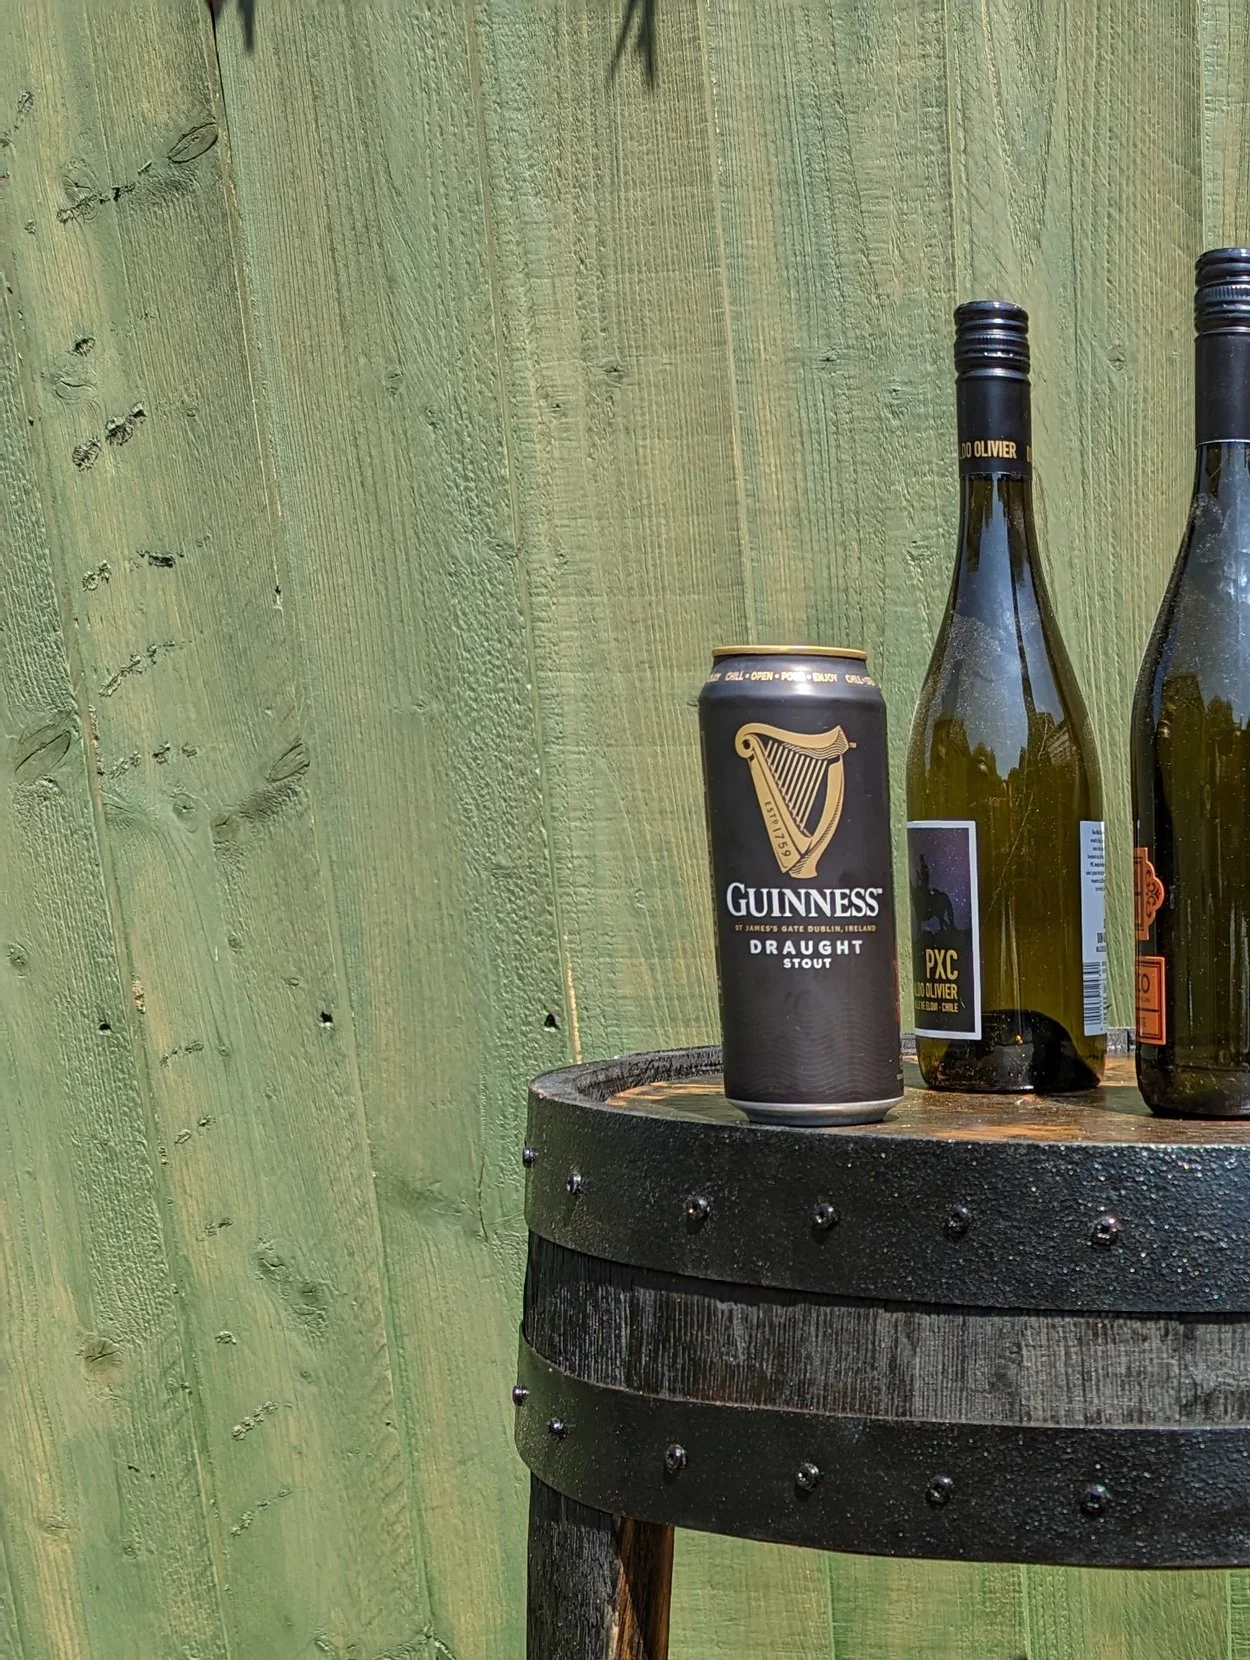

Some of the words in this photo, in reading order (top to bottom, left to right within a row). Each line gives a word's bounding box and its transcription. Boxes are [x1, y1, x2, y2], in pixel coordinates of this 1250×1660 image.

[974, 441, 1017, 459] OLIVIER
[751, 671, 774, 681] OPEN
[773, 827, 792, 857] 1759
[726, 882, 880, 918] GUINNESS
[781, 925, 804, 933] GATE
[845, 924, 877, 933] IRELAND
[749, 939, 863, 955] DRAUGHT
[783, 958, 832, 969] STOUT
[925, 949, 959, 981] PXC
[925, 983, 958, 1000] OLIVIER
